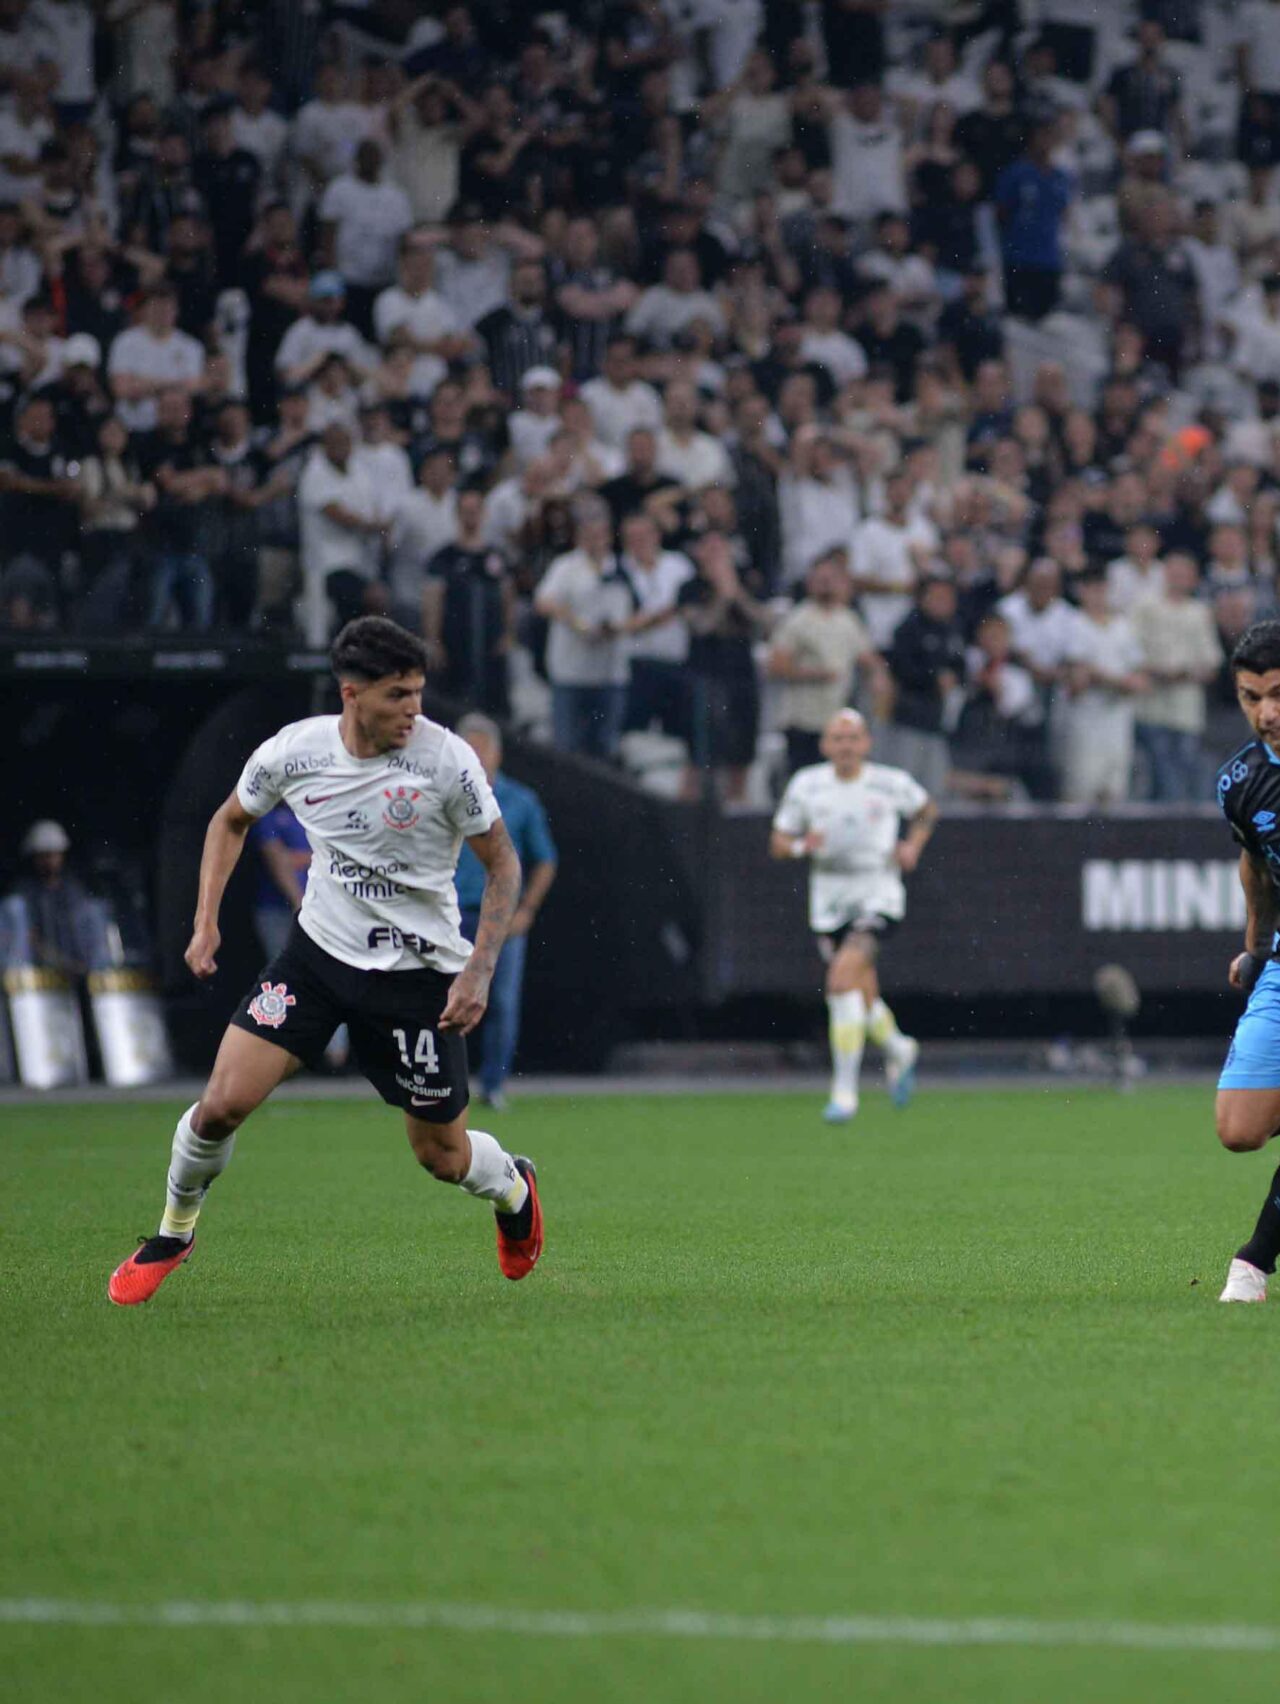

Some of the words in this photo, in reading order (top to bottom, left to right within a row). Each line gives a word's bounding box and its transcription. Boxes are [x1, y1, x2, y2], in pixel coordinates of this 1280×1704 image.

[284, 752, 338, 778] pixbet
[387, 755, 438, 780] pixbet
[392, 1028, 440, 1074] 14
